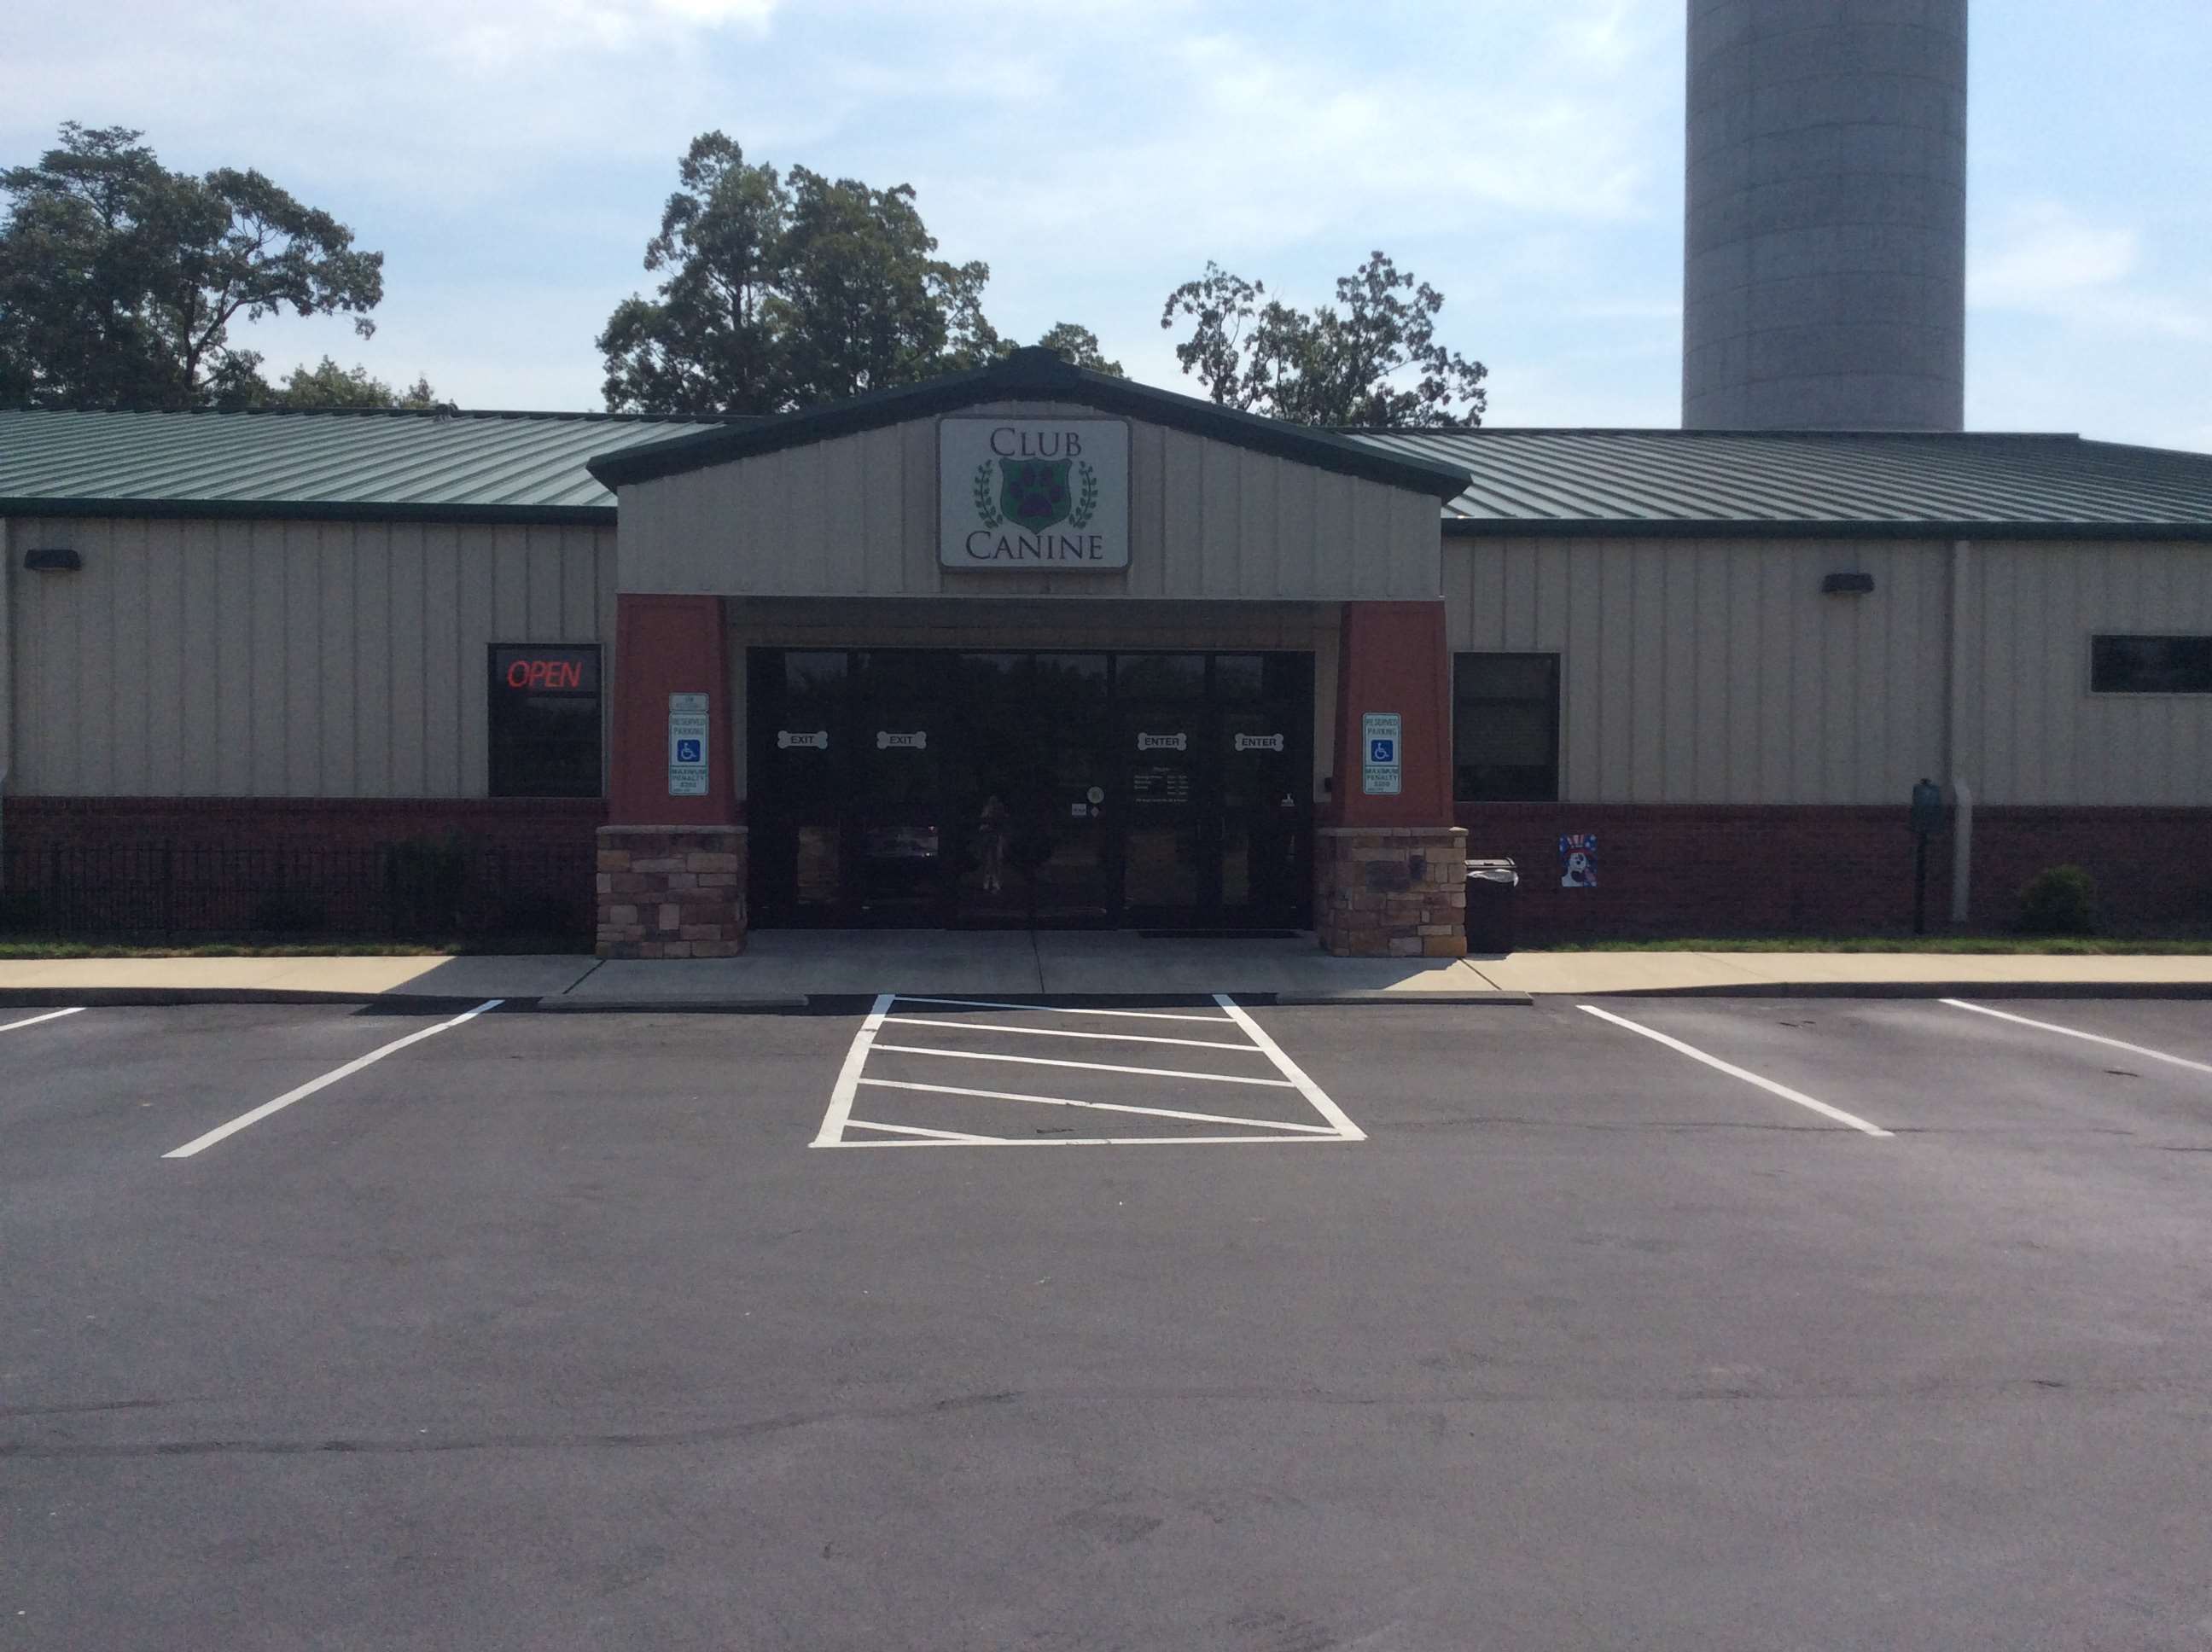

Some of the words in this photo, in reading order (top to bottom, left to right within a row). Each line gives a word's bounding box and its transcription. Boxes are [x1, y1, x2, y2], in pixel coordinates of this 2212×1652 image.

[990, 428, 1081, 457] CLUB
[965, 531, 1103, 560] CANINE
[507, 660, 583, 689] OPEN
[791, 736, 814, 745] EXIT
[889, 736, 912, 745] EXIT
[1144, 737, 1179, 746] ENTER
[1242, 738, 1276, 747] ENTER
